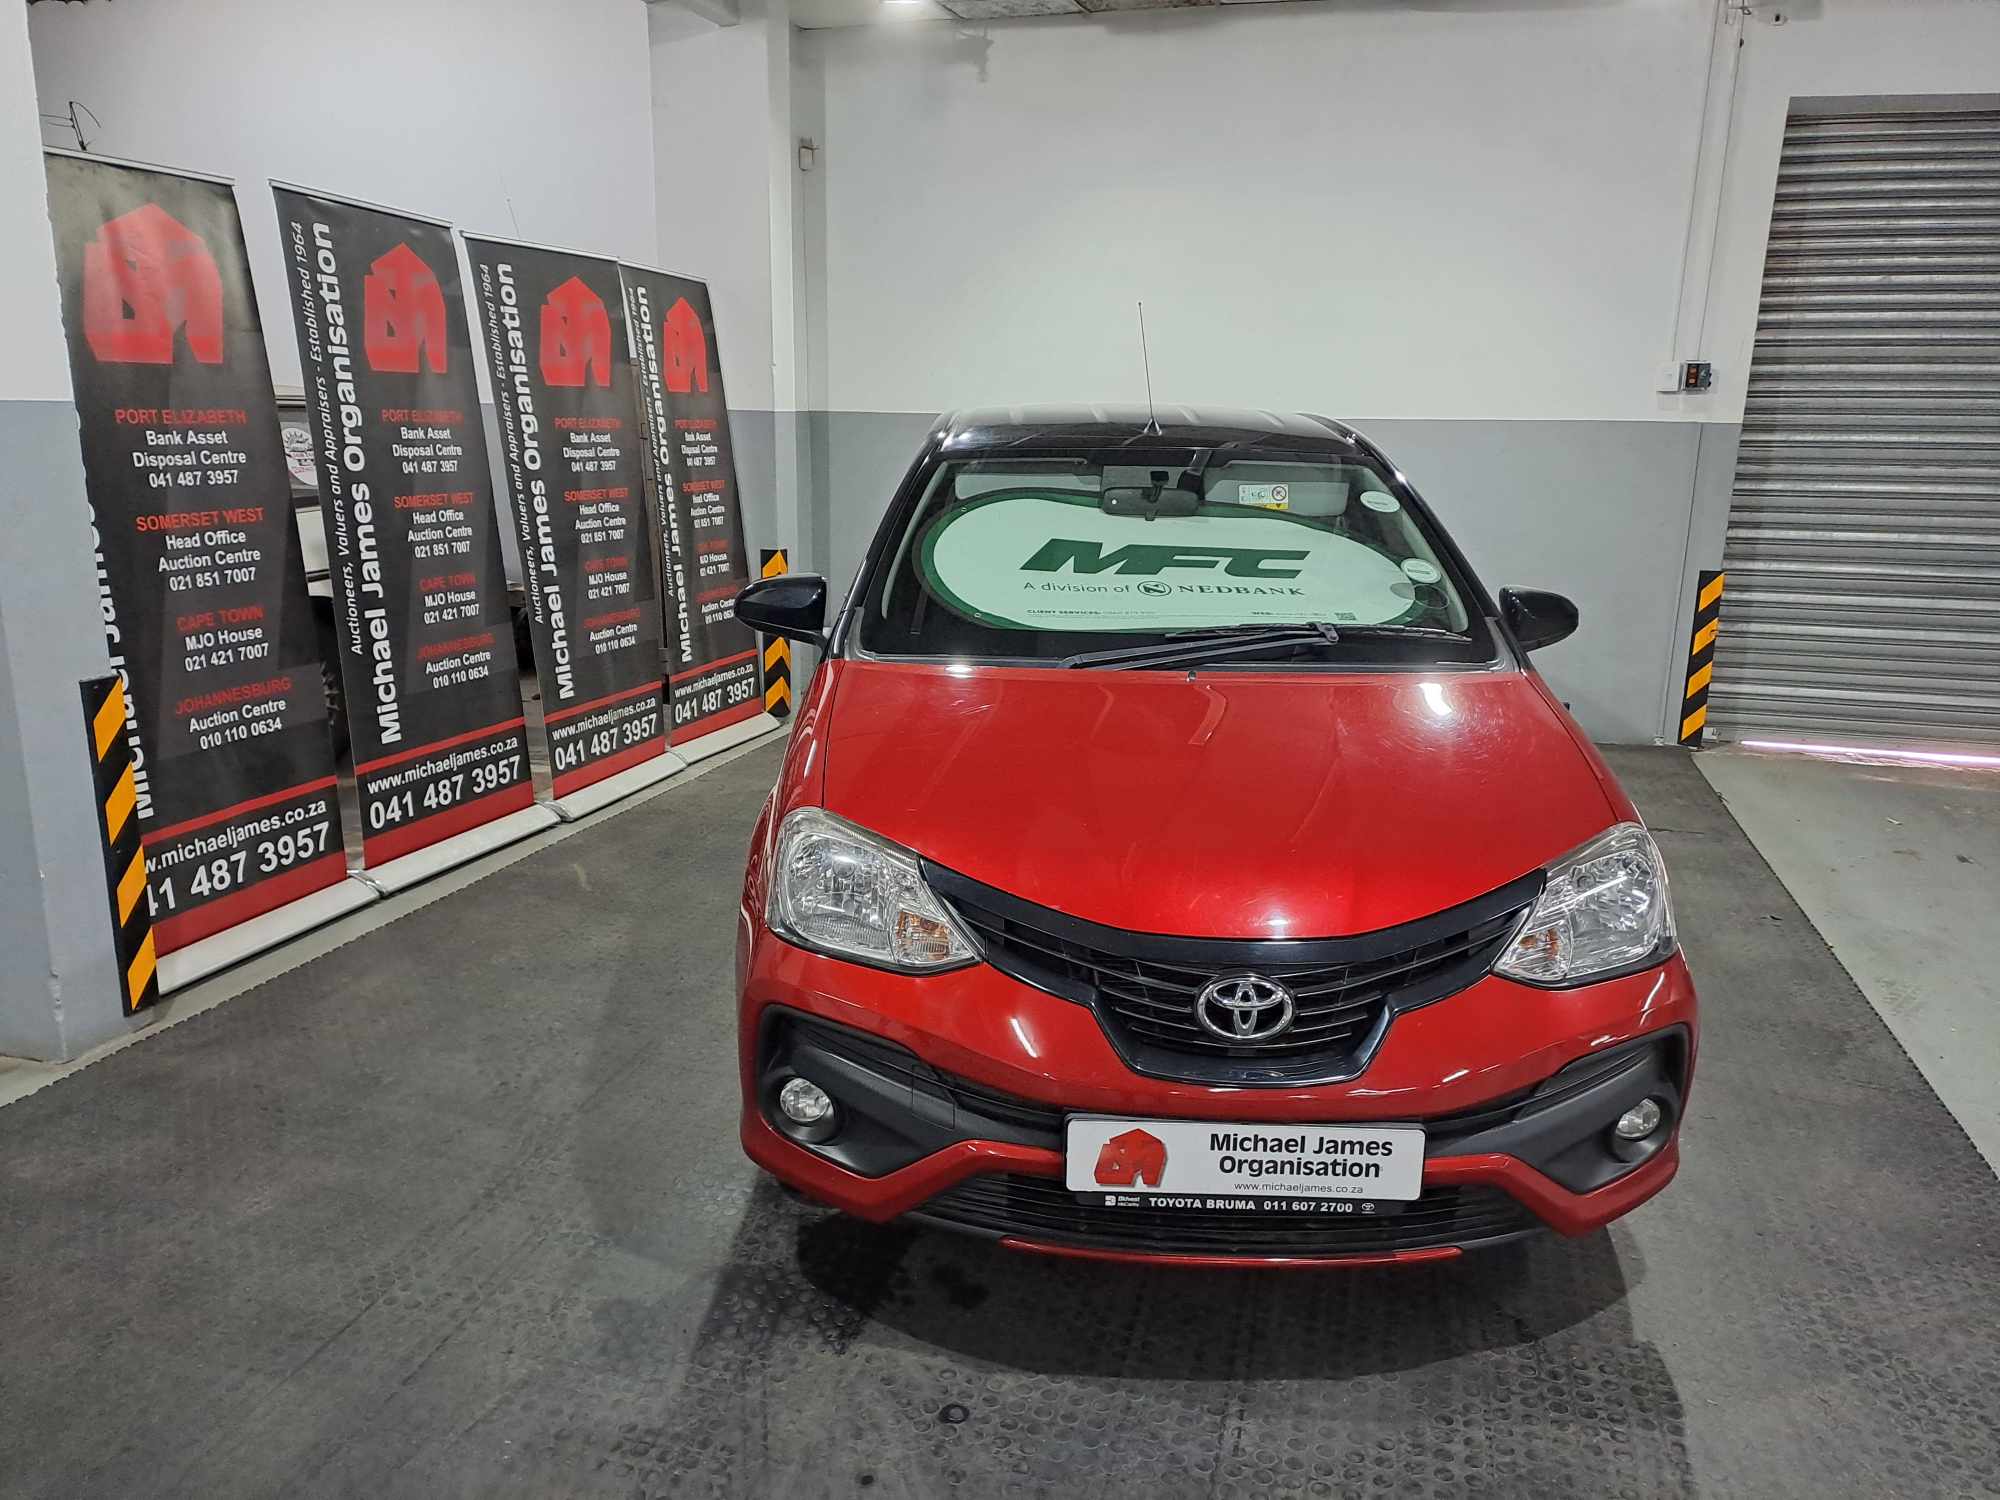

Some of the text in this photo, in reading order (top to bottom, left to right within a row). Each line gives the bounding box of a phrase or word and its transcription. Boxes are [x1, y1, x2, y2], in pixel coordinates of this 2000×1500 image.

[291, 222, 307, 263] 1964
[298, 267, 323, 361] Established
[116, 410, 157, 424] PORT
[316, 376, 338, 462] Appraisers
[146, 431, 228, 445] Bank Asset
[401, 427, 451, 439] Bank Asset
[480, 264, 544, 623] Auctioneers, Valuers and Appraisers Established 1964
[570, 433, 611, 443] Bank Asset
[133, 451, 246, 469] Disposal Centre
[392, 444, 462, 459] Disposal Centre
[563, 447, 620, 459] Disposal Centre
[403, 460, 457, 473] 041 487 3957
[149, 470, 238, 487] 041 487 3957
[312, 222, 401, 744] Michael James organisation
[328, 467, 341, 494] and
[497, 264, 575, 699] Michael James organisation
[137, 507, 263, 532] SOMERSET WEST
[413, 510, 464, 524] Head Office
[598, 503, 619, 513] Office
[664, 473, 680, 556] James
[332, 499, 349, 555] Valuers
[408, 526, 472, 541] Auction Centre
[576, 517, 626, 529] Auction Centre
[166, 530, 246, 549] Head Office
[415, 541, 470, 558] 021 851 7007
[159, 549, 260, 572] Auction Centre
[1020, 538, 1310, 579] MFC
[170, 567, 255, 591] 021 851 7007
[605, 572, 627, 582] House
[1024, 582, 1130, 593] A division of
[425, 591, 475, 607] MJO House
[1178, 585, 1306, 596] NEDBANK
[221, 607, 264, 623] TOWN
[343, 563, 362, 654] Auctioneers,
[424, 604, 479, 624] 021 421 7007
[674, 564, 693, 663] Michael
[185, 628, 262, 651] MJO House
[590, 624, 637, 641] Auction Centre
[185, 643, 268, 671] 021 421 7007
[426, 652, 490, 676] Auction Centre
[433, 665, 488, 688] 010 110 0634
[177, 678, 292, 714] JOHANNESBURG
[675, 677, 754, 723] 041 487 3957
[190, 701, 286, 734] Auction Centre
[552, 698, 656, 743] www.michaeljames.co.za
[200, 717, 282, 749] 010 110 0634
[555, 713, 656, 770] 041 487 3957
[367, 737, 519, 794] www.michaeljames.co.za
[370, 752, 520, 828] 041 487 3957
[188, 850, 246, 896] 487
[258, 820, 329, 871] 3957
[1210, 1134, 1392, 1157] Michael James
[1220, 1156, 1380, 1178] Organisation
[1234, 1182, 1363, 1194] www.michaeljames.co.za
[1149, 1198, 1352, 1212] TOYOTA BRUMA 011 607 2700
